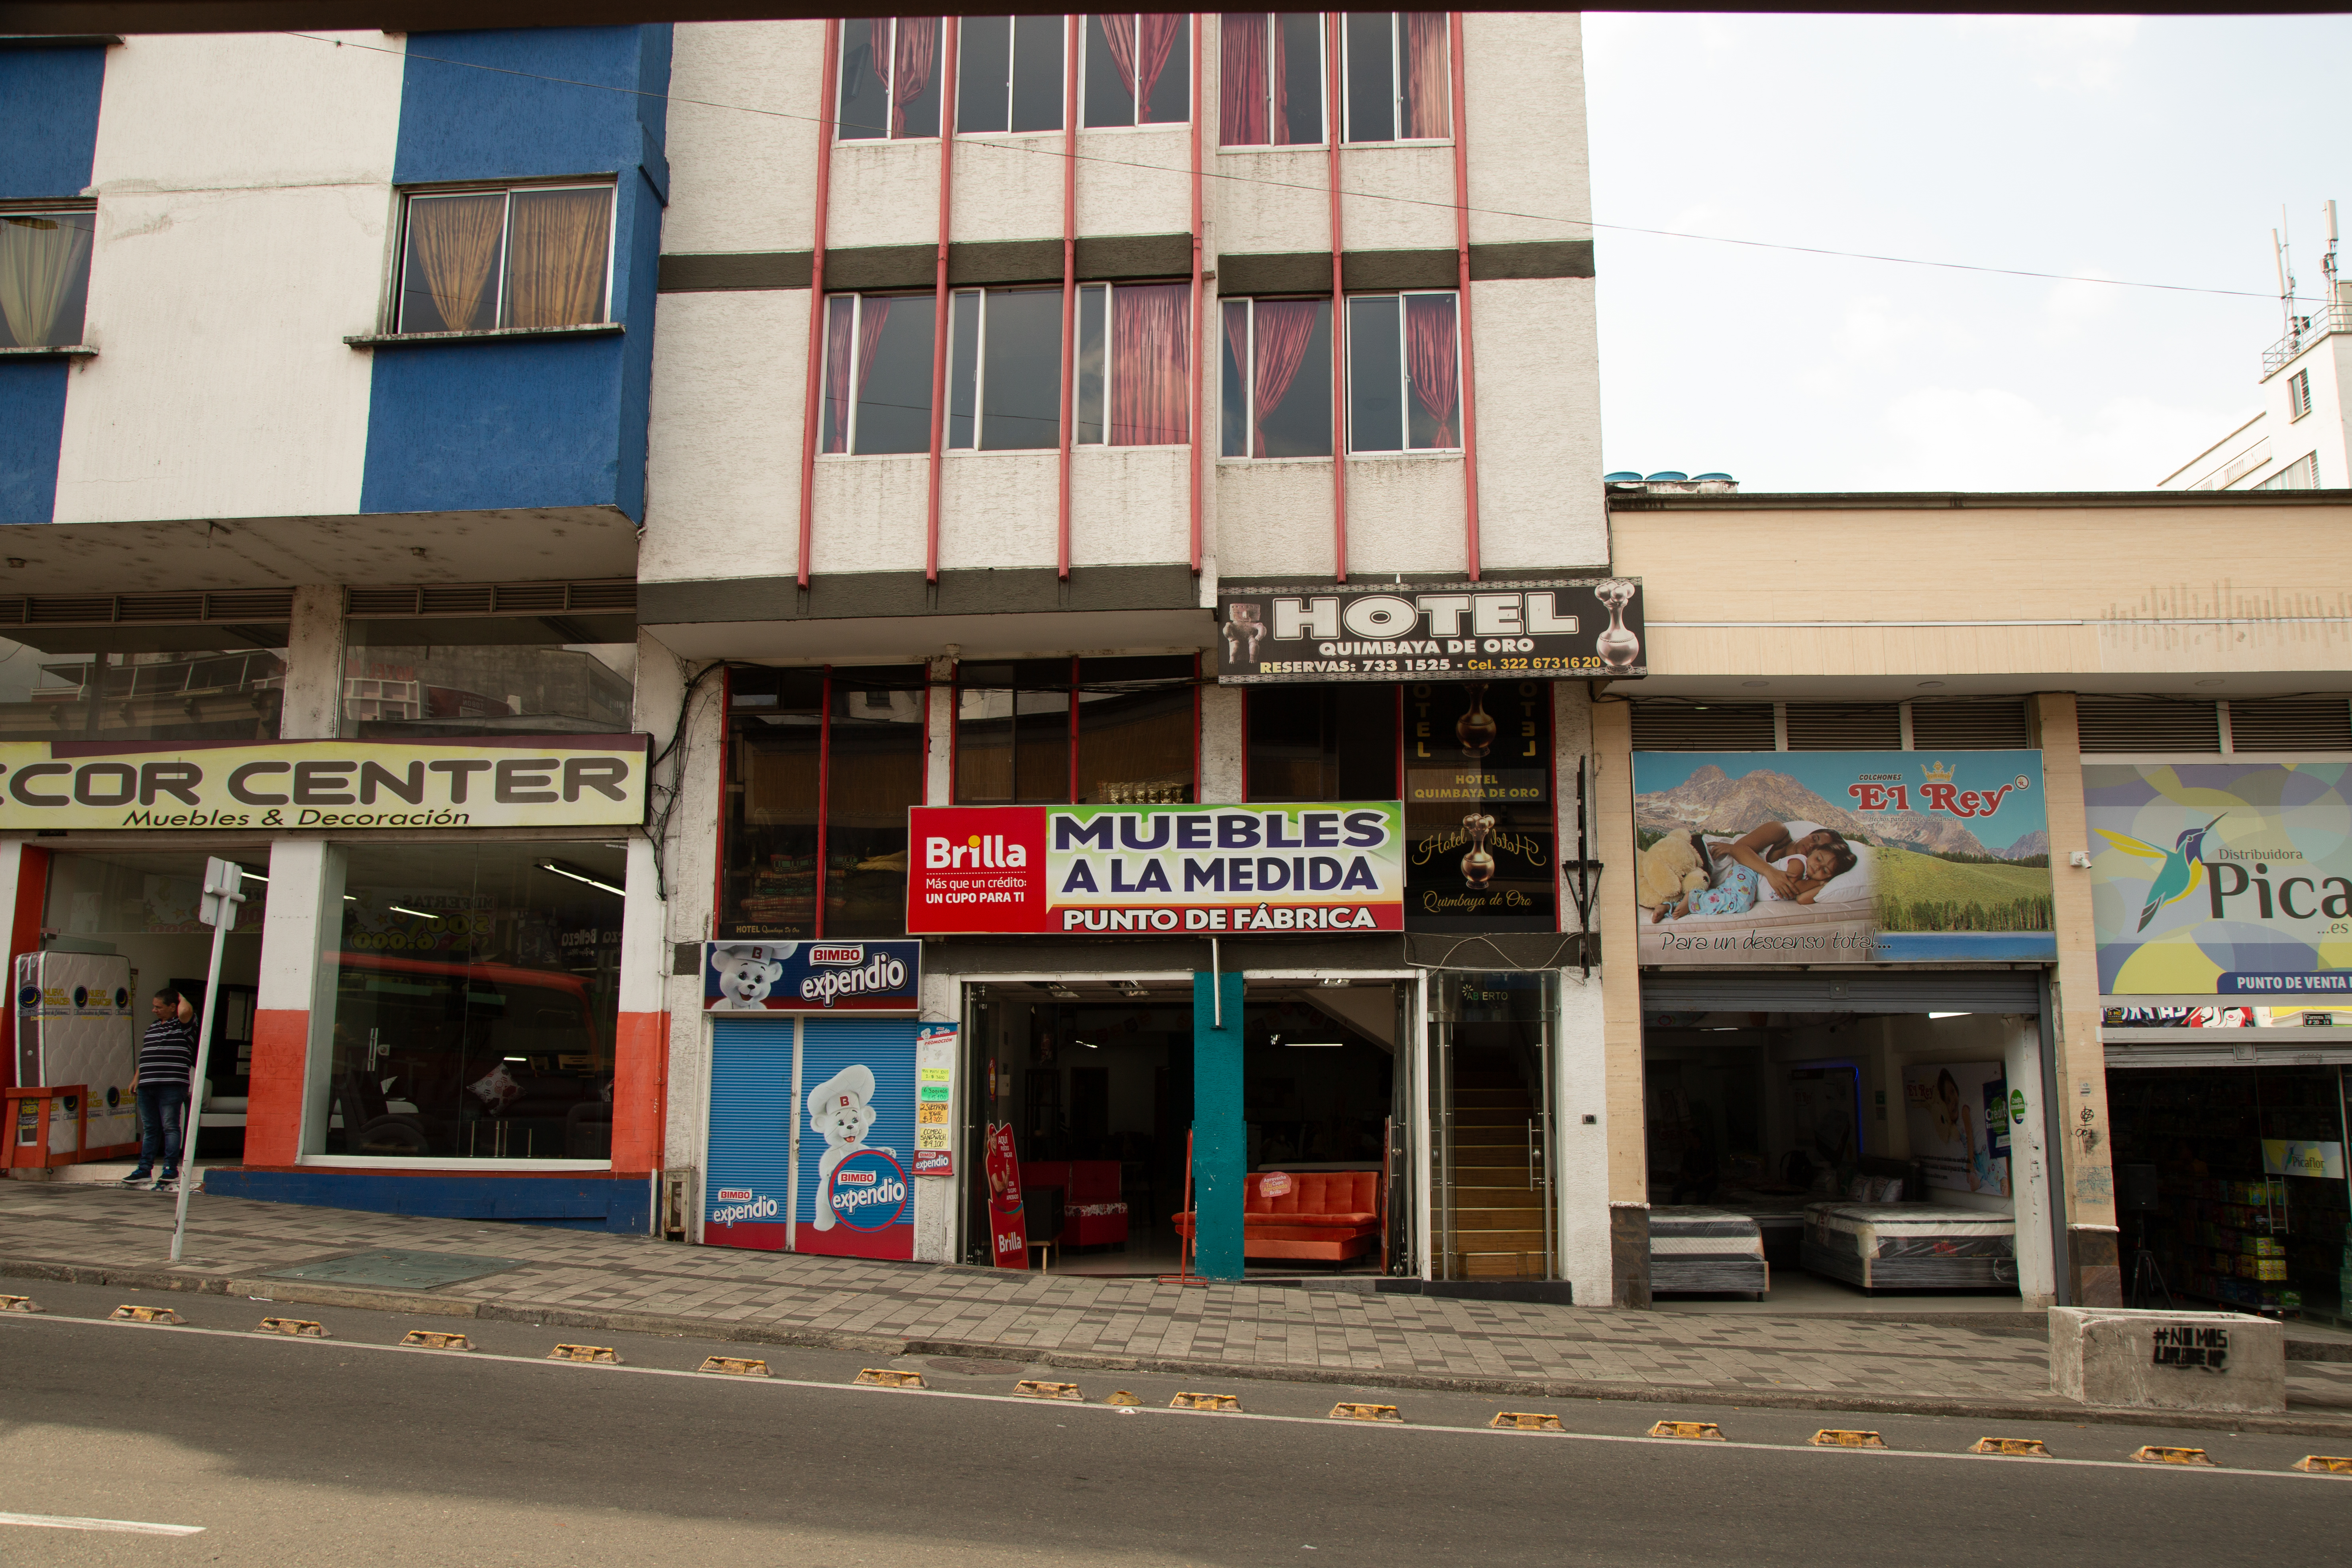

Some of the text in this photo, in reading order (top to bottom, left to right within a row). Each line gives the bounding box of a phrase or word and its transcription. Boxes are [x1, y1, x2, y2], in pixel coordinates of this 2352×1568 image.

[1273, 592, 1579, 640] HOTEL
[1319, 638, 1535, 657] QUIMBAYA DE ORO
[1260, 660, 1356, 673] RESERVAS:
[1363, 659, 1397, 672] 733
[1405, 658, 1450, 671] 1525
[1467, 658, 1496, 671] Cel.
[1500, 657, 1529, 670] 322
[0, 758, 629, 806] COR CENTER
[1456, 775, 1498, 785] HOTEL
[1415, 788, 1539, 798] QUIMBAYA DE ORO
[1849, 783, 2013, 818] El Rey
[123, 809, 469, 826] Muebles & Decoración
[1054, 812, 1385, 850] MUEBLES
[926, 835, 1026, 869] Brilla
[1412, 828, 1467, 865] Hotel
[2218, 849, 2303, 860] Distribuidora
[1062, 856, 1378, 893] A LA MEDIDA
[926, 876, 1027, 891] Más que un crédito:
[926, 891, 1024, 904] UN CUPO PARA TI
[1423, 890, 1532, 913] Quimbaya de Oro
[1063, 903, 1376, 931] PUNTO DE FÁBRICA
[1659, 931, 1710, 951] Para
[1714, 935, 1738, 951] un
[1742, 929, 1825, 951] descanso
[813, 948, 860, 962] BIMBO
[802, 953, 905, 1005] expendio
[2237, 977, 2282, 989] PUNTO
[2285, 977, 2302, 989] DE
[2304, 976, 2346, 989] VENTA
[44, 988, 65, 997] NUEVO
[43, 997, 70, 1005] RENACER
[88, 998, 112, 1006] RENACER
[924, 1037, 953, 1046] PROMOCIÓN
[1985, 1107, 2008, 1121] Crédit
[915, 1155, 949, 1172] expendio
[2292, 1156, 2325, 1168] Picaflor
[841, 1173, 874, 1183] BIMBO
[721, 1190, 750, 1199] BIMBO
[1263, 1183, 1288, 1192] Aprobado
[832, 1178, 906, 1214] expendio
[713, 1195, 778, 1227] expendio
[998, 1232, 1022, 1253] Brilla
